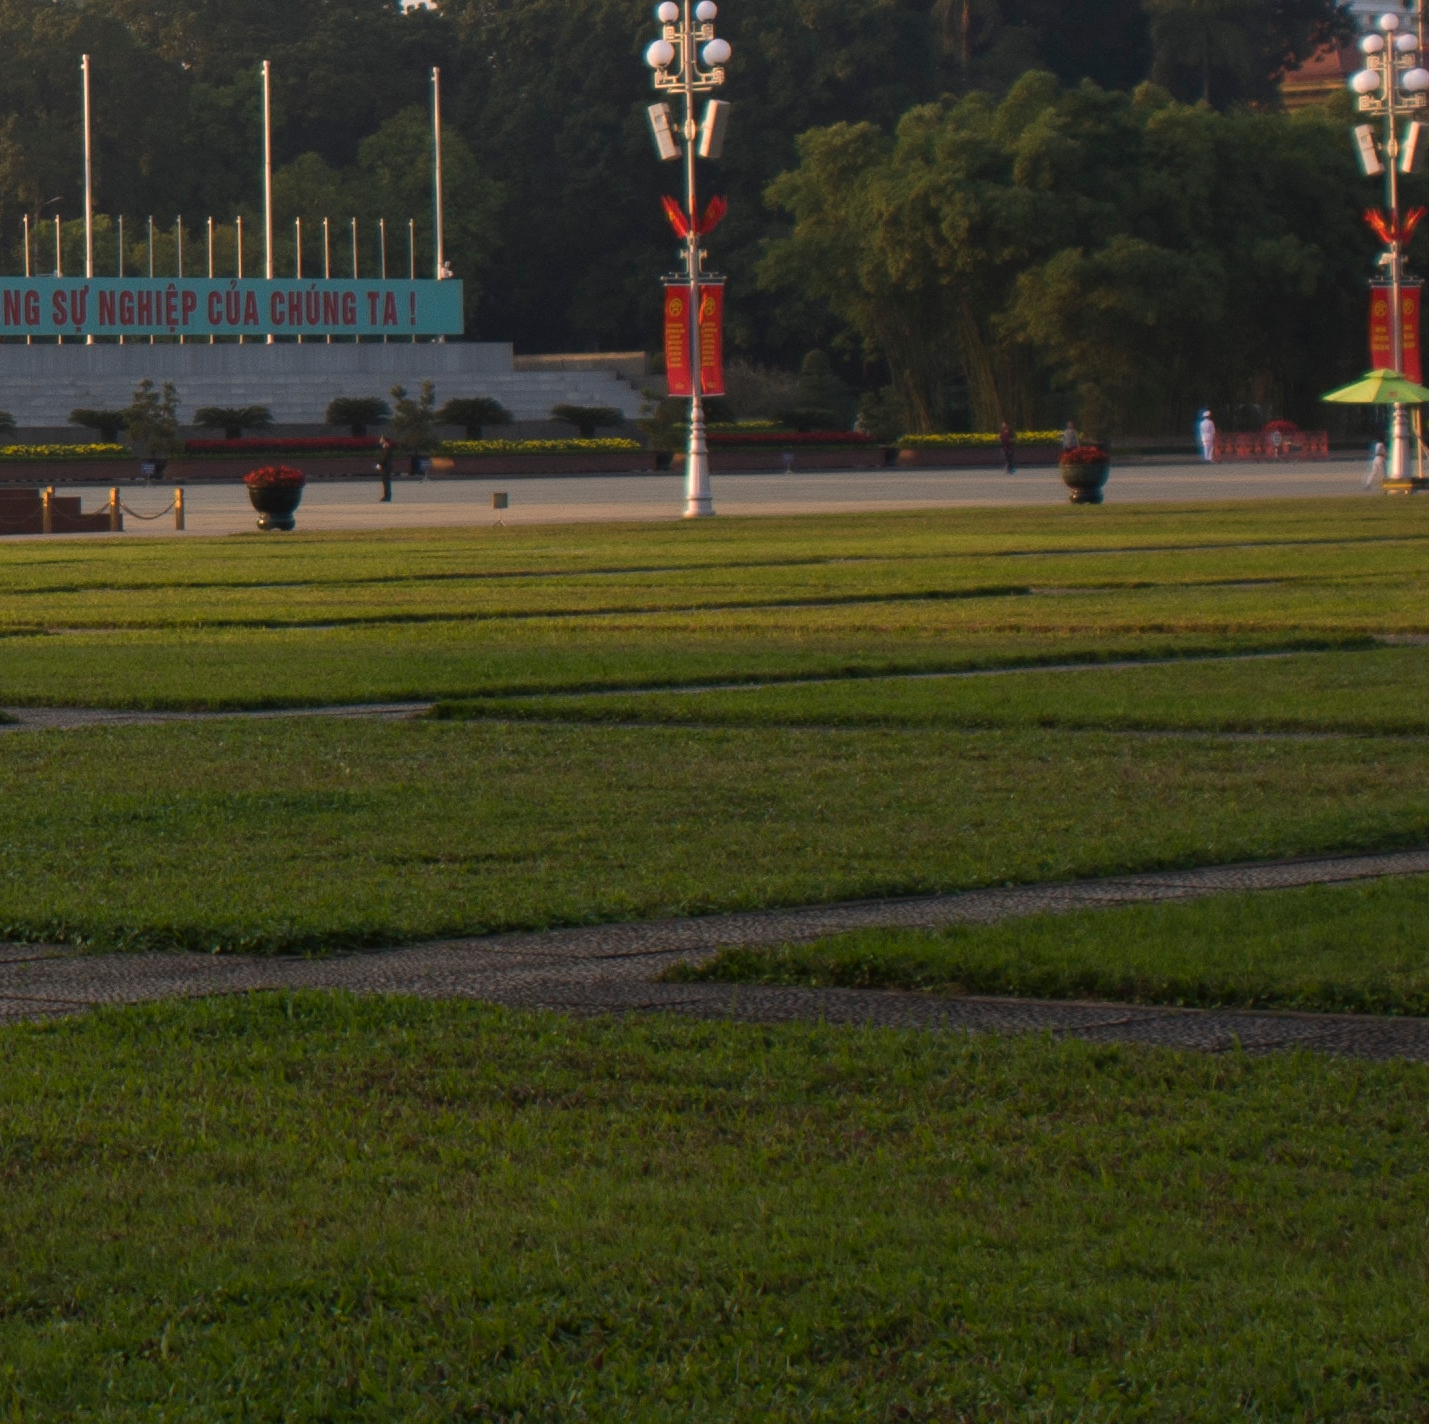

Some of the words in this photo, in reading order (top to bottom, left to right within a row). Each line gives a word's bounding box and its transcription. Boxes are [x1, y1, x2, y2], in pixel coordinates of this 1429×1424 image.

[52, 284, 89, 333] SỰ
[99, 283, 196, 333] NGHIỆP
[208, 280, 259, 326] CỦA
[270, 284, 356, 326] CHÚNG
[367, 291, 398, 326] TA
